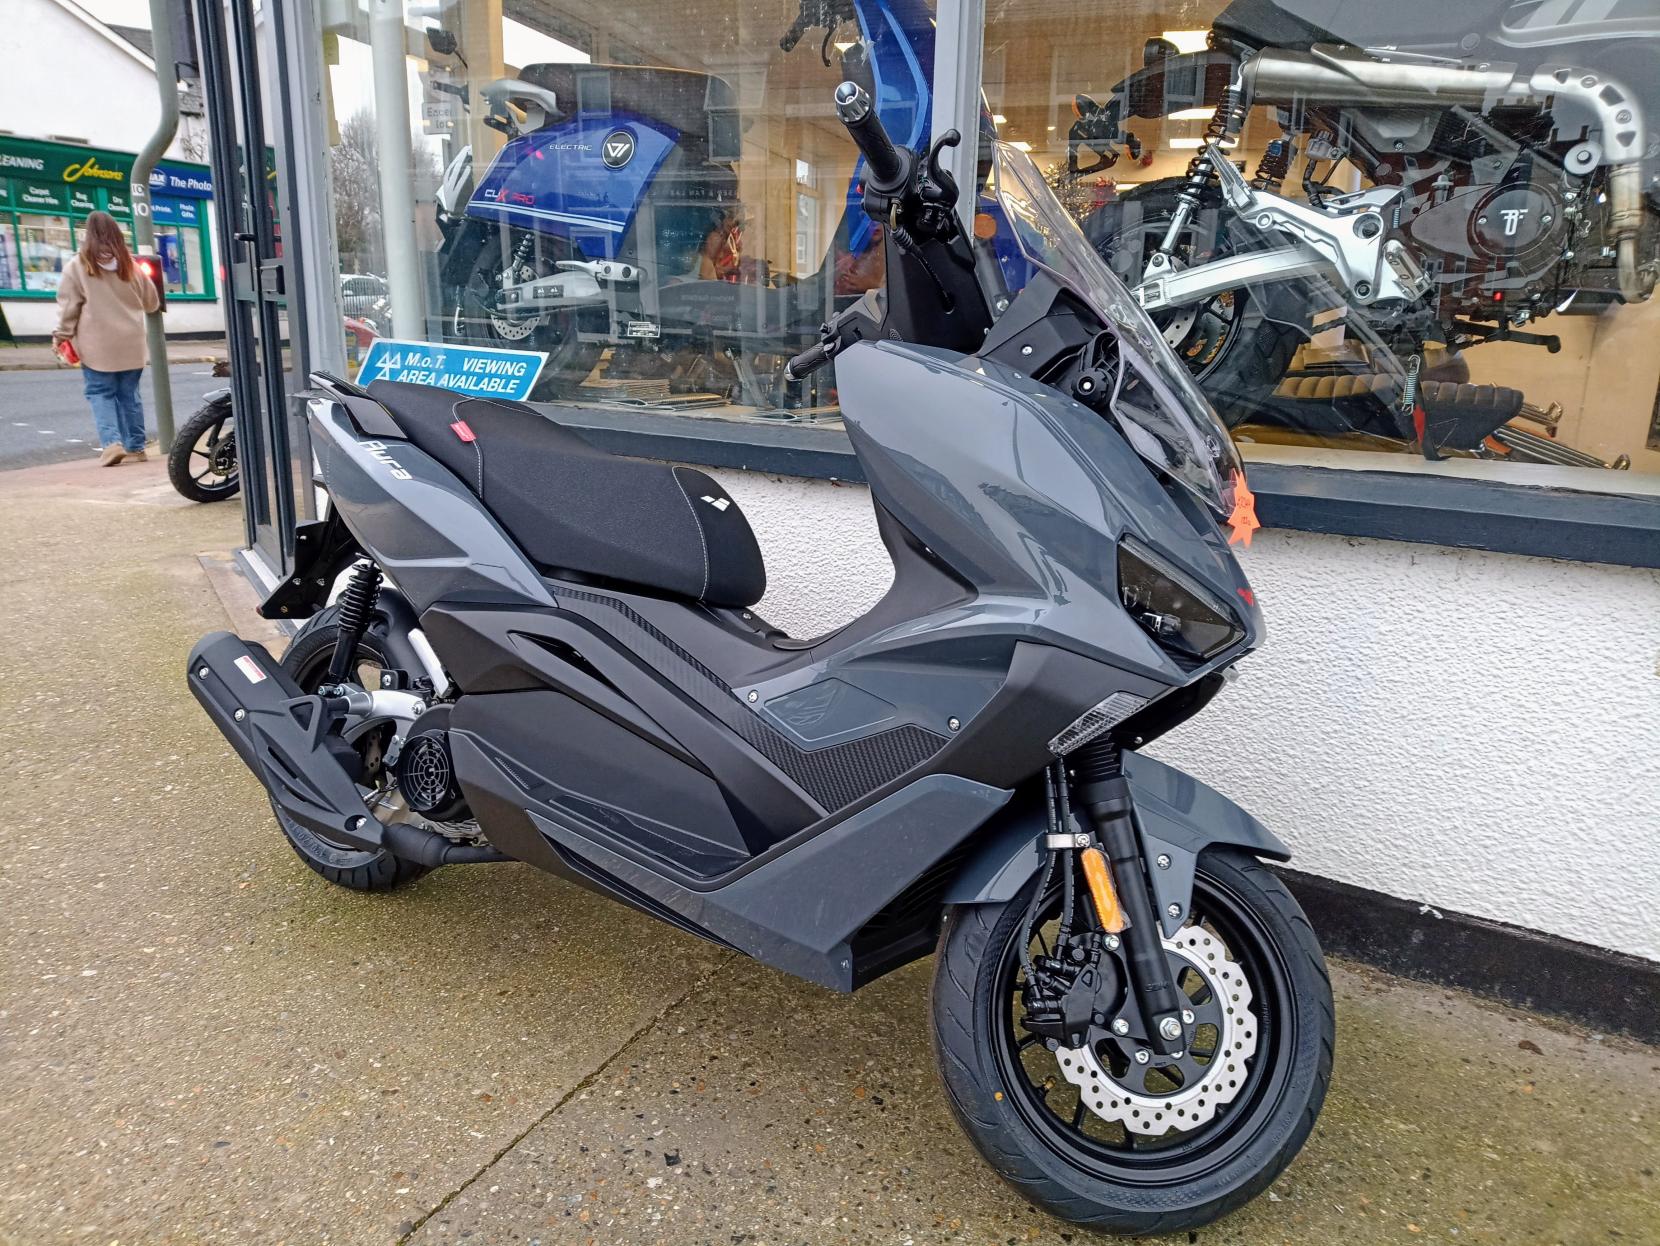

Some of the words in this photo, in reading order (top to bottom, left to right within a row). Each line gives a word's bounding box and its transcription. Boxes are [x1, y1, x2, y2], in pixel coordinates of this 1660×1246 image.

[549, 143, 593, 151] ELECTRIC
[63, 157, 124, 182] Johnsons
[170, 176, 187, 189] The
[187, 178, 212, 191] Photo
[132, 202, 149, 217] 10
[462, 357, 527, 376] VIEWING
[397, 369, 437, 386] AREA
[436, 375, 520, 394] AVAILABLE
[358, 440, 413, 480] Aura
